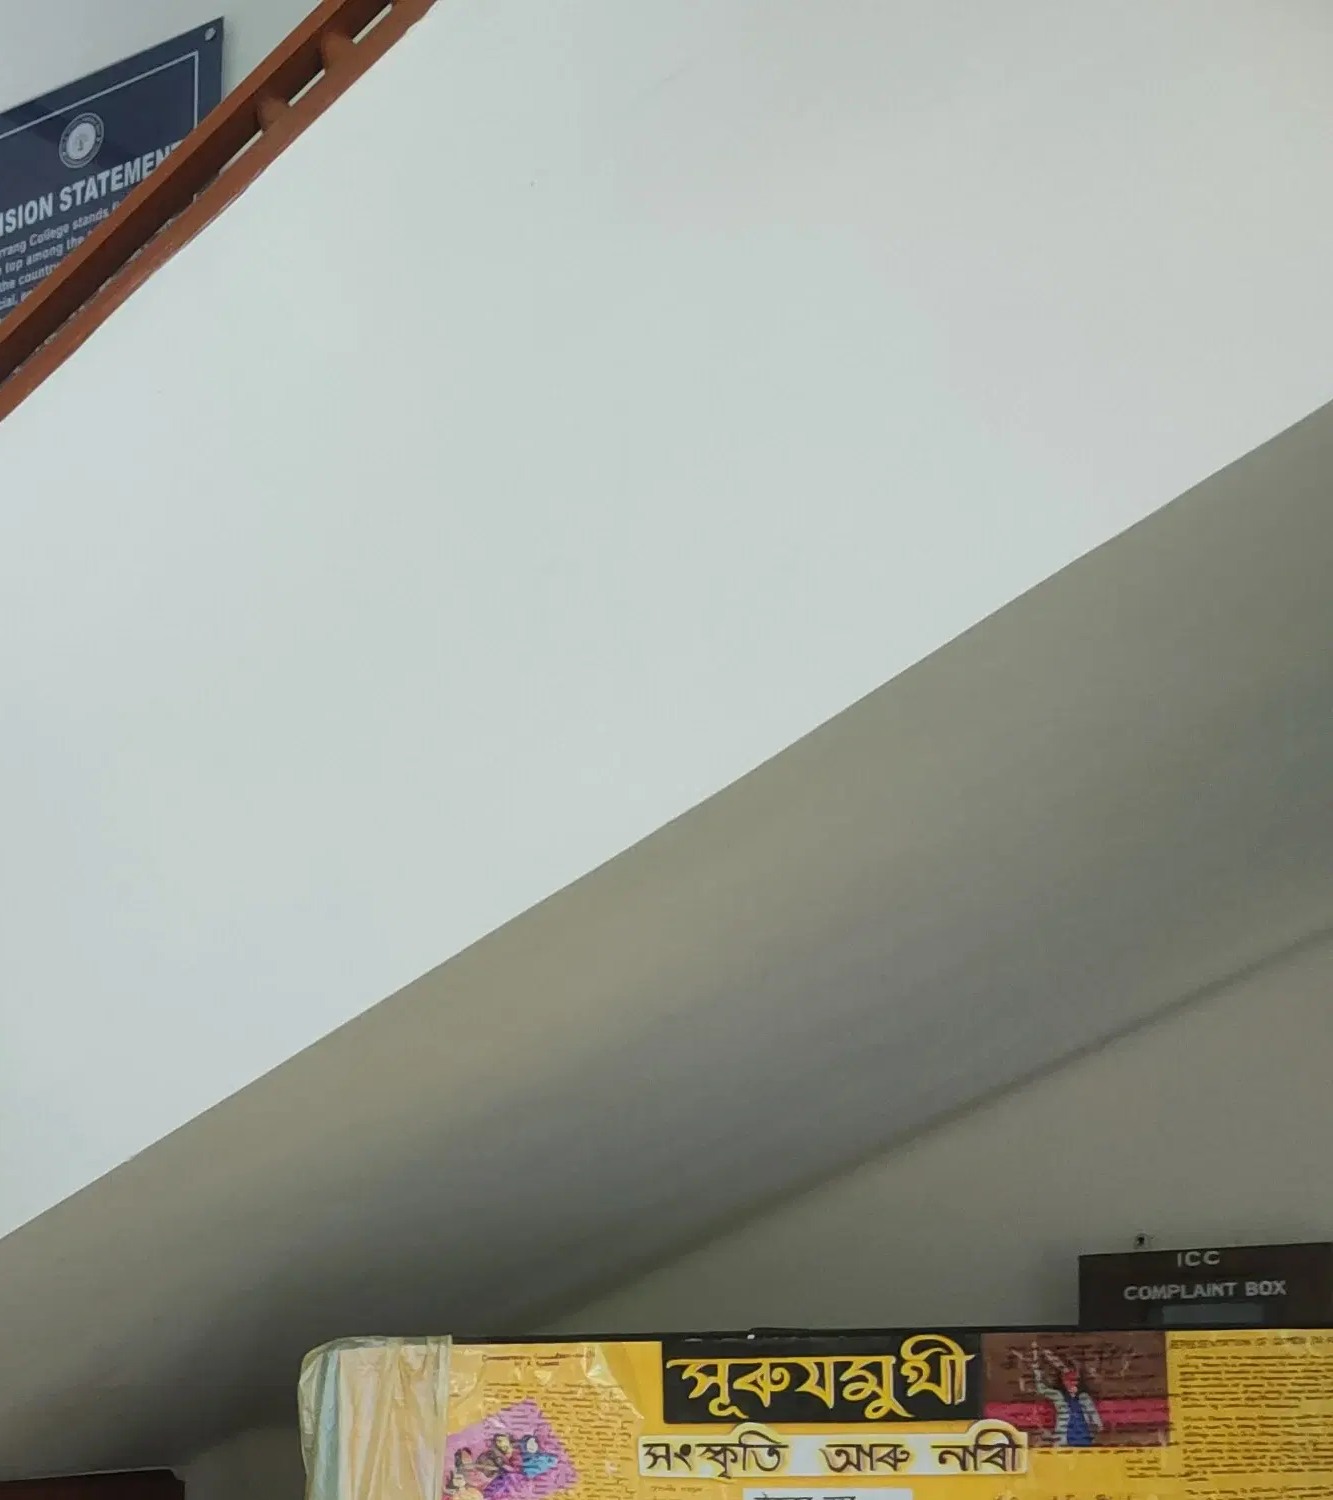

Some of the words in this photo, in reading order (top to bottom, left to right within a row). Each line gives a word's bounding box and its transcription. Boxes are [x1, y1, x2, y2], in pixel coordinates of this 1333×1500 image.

[59, 140, 183, 212] STATEMEN
[29, 223, 70, 246] College
[5, 258, 23, 274] top
[26, 243, 63, 267] among
[1176, 1250, 1221, 1267] ICC
[1123, 1282, 1239, 1301] COMPLAINT
[1244, 1280, 1287, 1297] BOX
[642, 1430, 789, 1479] সংস্কৃতি
[819, 1442, 911, 1472] আৰু
[931, 1428, 1023, 1472] নাৰী
